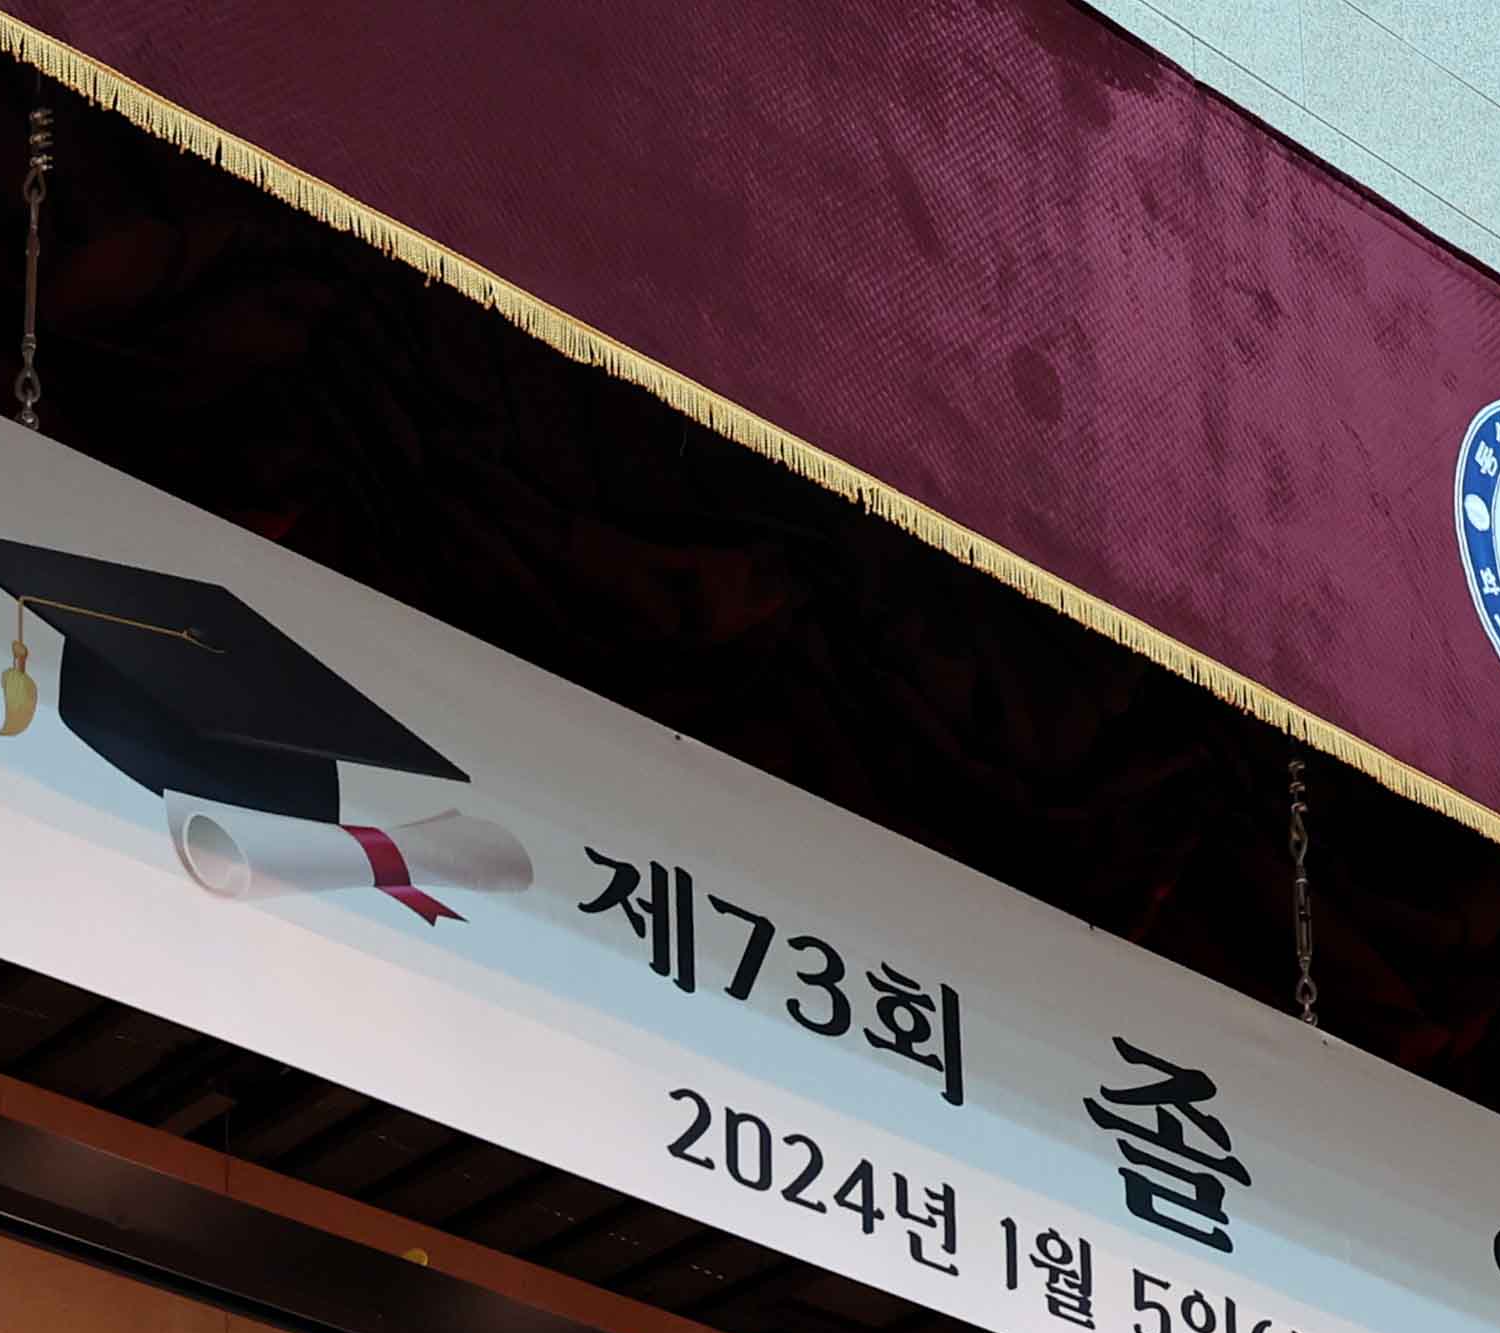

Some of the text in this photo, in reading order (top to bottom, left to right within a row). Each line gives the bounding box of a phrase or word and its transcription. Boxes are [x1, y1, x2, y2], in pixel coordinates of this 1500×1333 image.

[577, 846, 964, 1107] 제73회
[667, 1089, 959, 1275] 2024년
[1001, 1216, 1095, 1330] 1월
